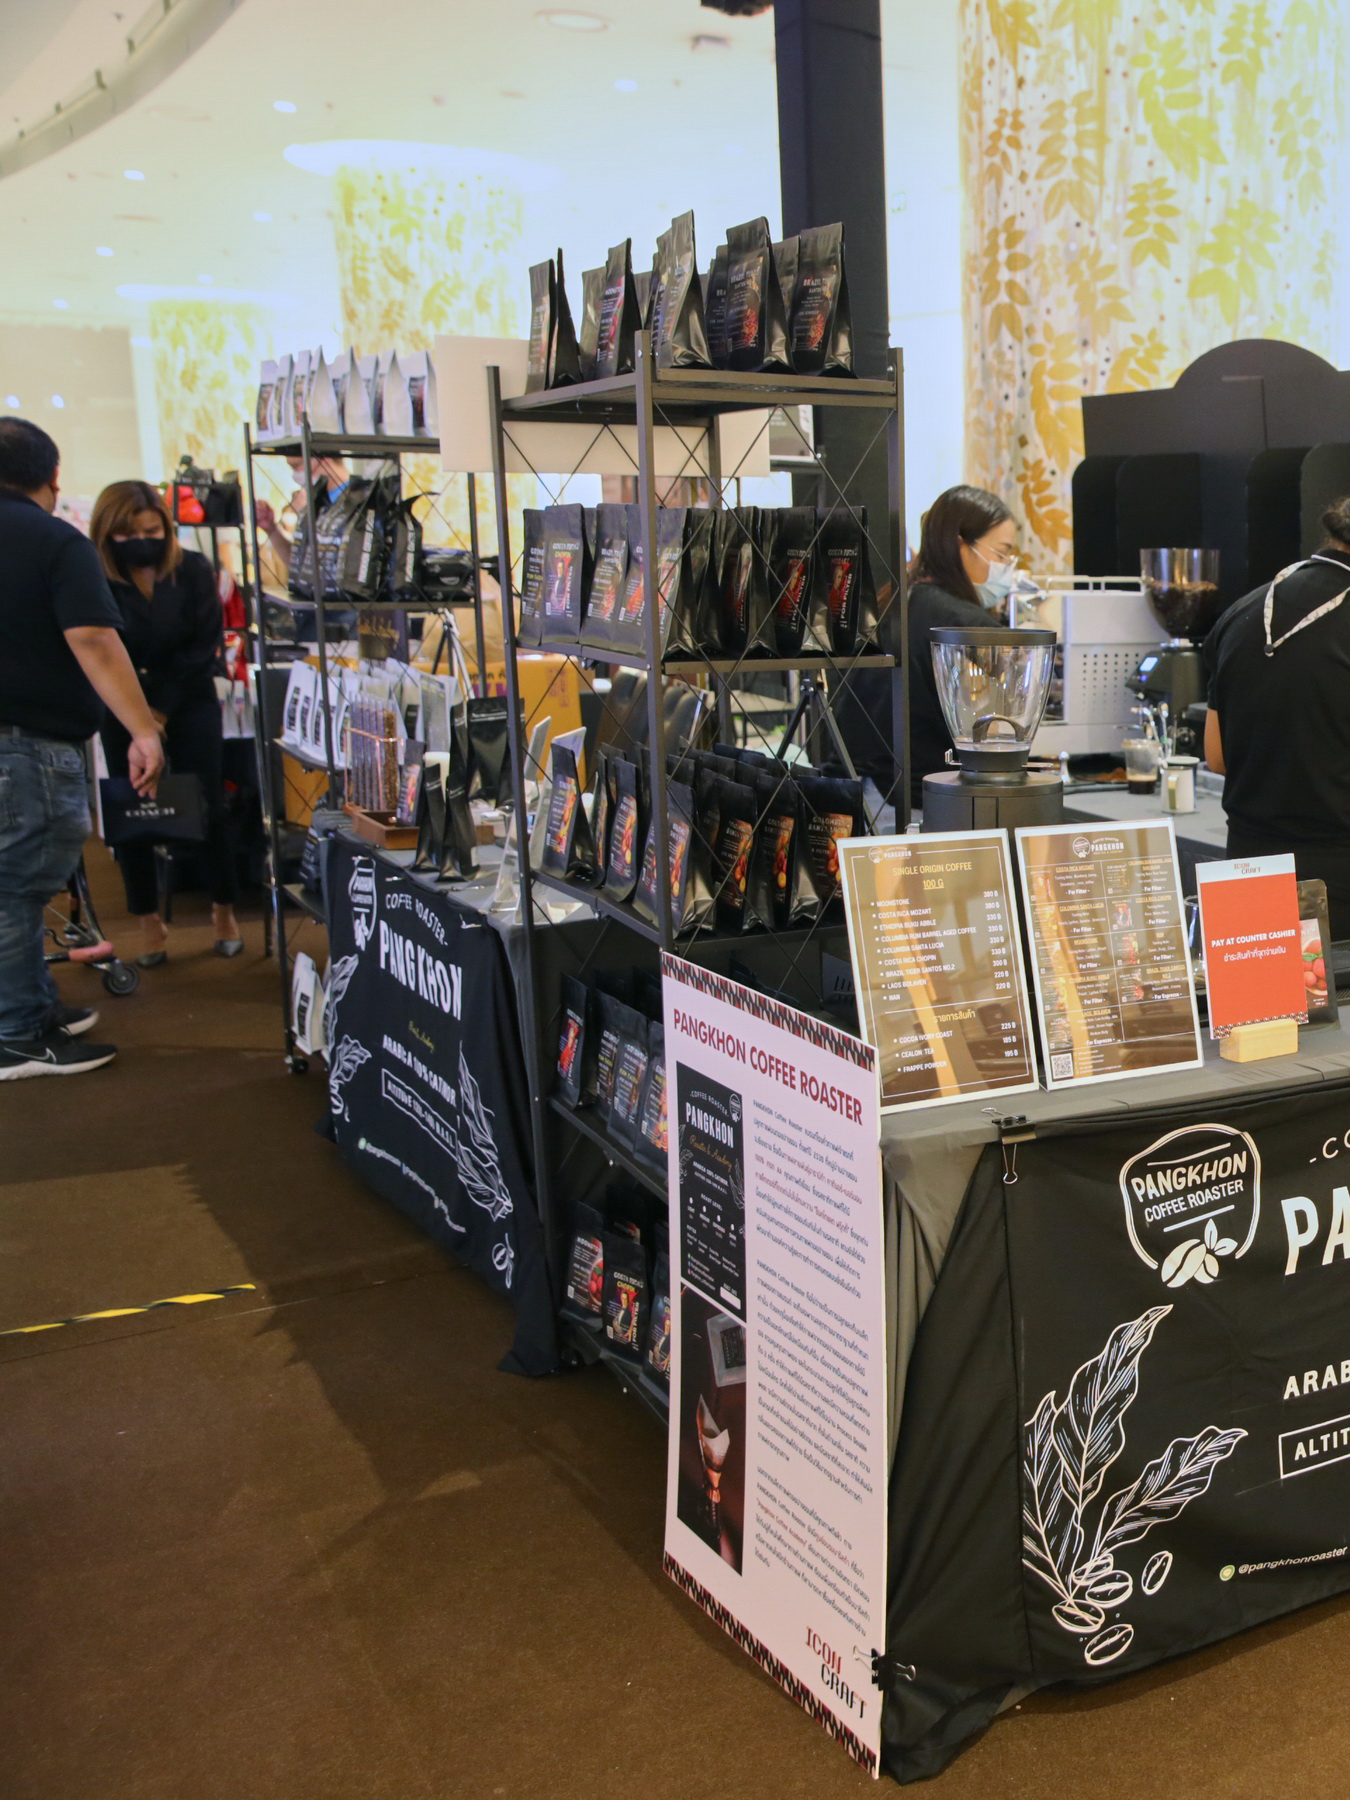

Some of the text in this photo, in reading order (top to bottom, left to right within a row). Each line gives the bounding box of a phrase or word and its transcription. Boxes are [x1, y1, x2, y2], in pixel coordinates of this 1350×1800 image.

[1091, 842, 1125, 852] PANGKHON
[892, 861, 973, 876] SINGLE ORIGIN COFFEE
[923, 878, 944, 890] 100 G
[910, 907, 932, 916] MOZART
[957, 926, 977, 935] COFFEE
[1211, 939, 1225, 948] PAY
[1235, 931, 1268, 944] COUNTER
[1268, 929, 1296, 940] CASHIER
[379, 919, 463, 1021] PANGKHON
[899, 1035, 919, 1044] COCOA
[935, 1030, 953, 1039] COAST
[901, 1050, 923, 1059] CEALON
[924, 1048, 935, 1056] TEA
[673, 1008, 747, 1065] PANGKHON
[749, 1046, 797, 1090] COFFEE
[800, 1069, 863, 1126] ROASTER
[903, 1064, 924, 1073] FRAPPE
[924, 1061, 948, 1071] POWDER
[685, 1101, 734, 1149] PANGKHON
[1130, 1150, 1248, 1203] PANGKHON
[1143, 1178, 1245, 1225] COFFEE ROASTER
[1237, 1545, 1348, 1576] @pangkhonroaster
[805, 1626, 841, 1675] ICON
[821, 1663, 867, 1718] CRAFT
